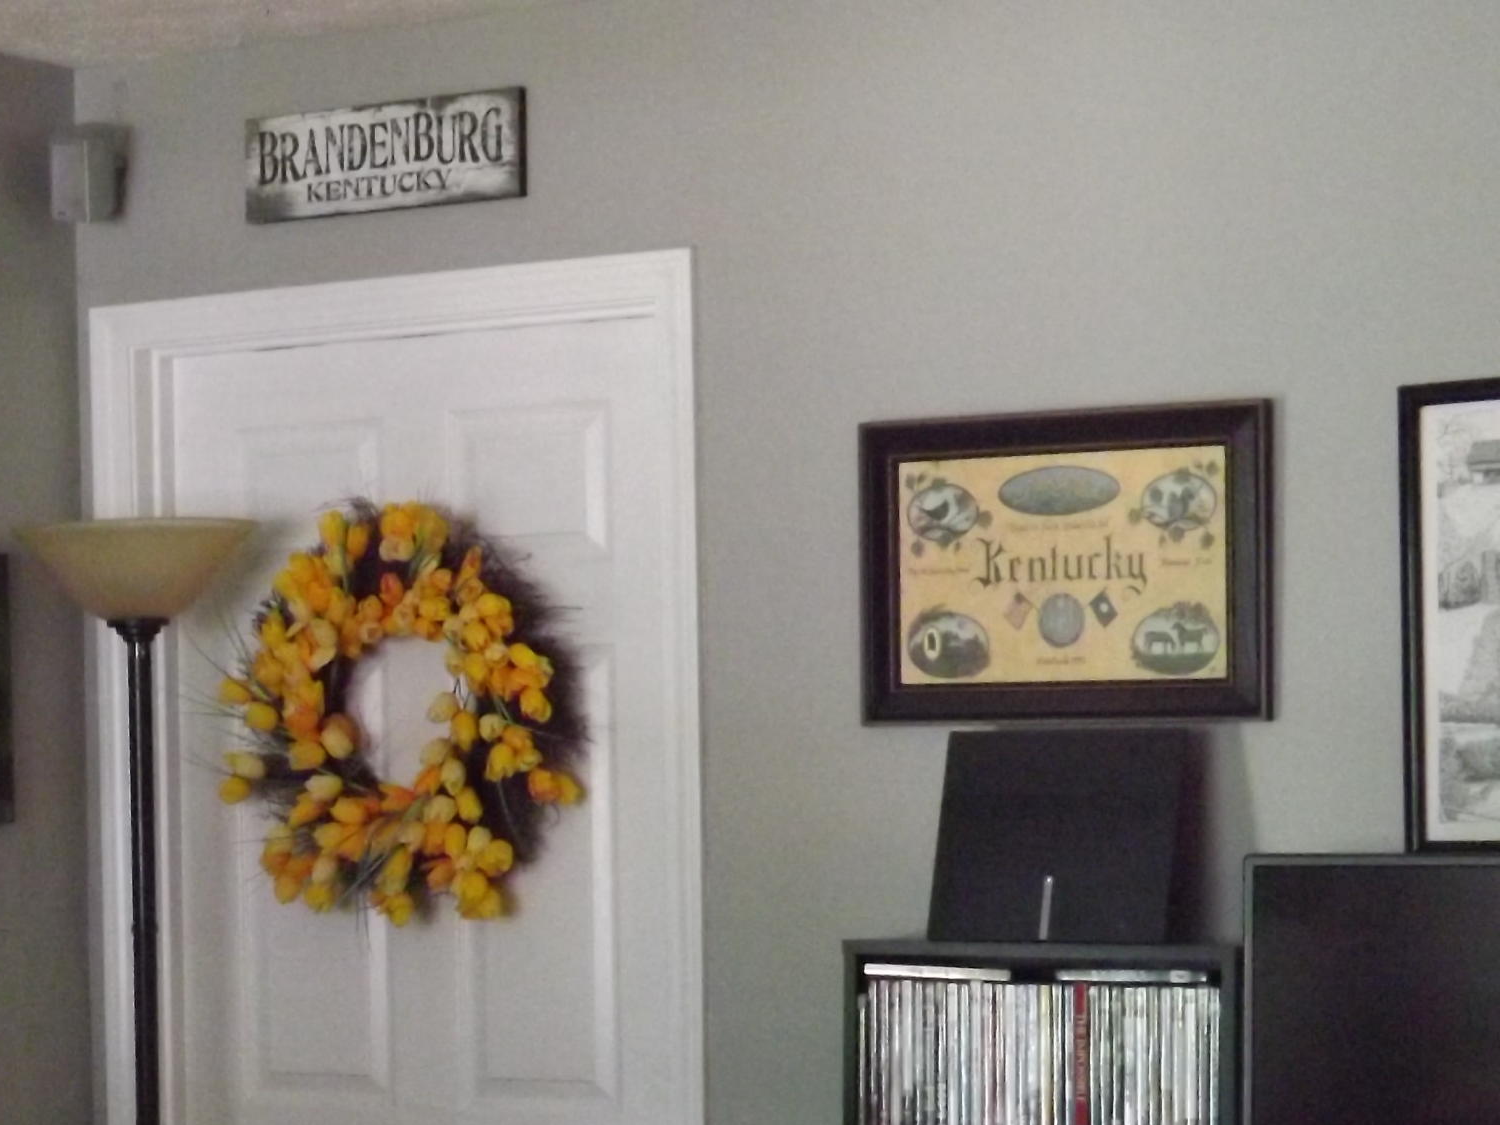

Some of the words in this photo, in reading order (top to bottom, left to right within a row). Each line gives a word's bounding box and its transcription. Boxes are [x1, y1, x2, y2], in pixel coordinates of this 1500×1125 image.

[258, 107, 504, 186] BRANDENBURG
[306, 168, 453, 204] KENTUCKY
[970, 533, 1148, 595] Kentucky
